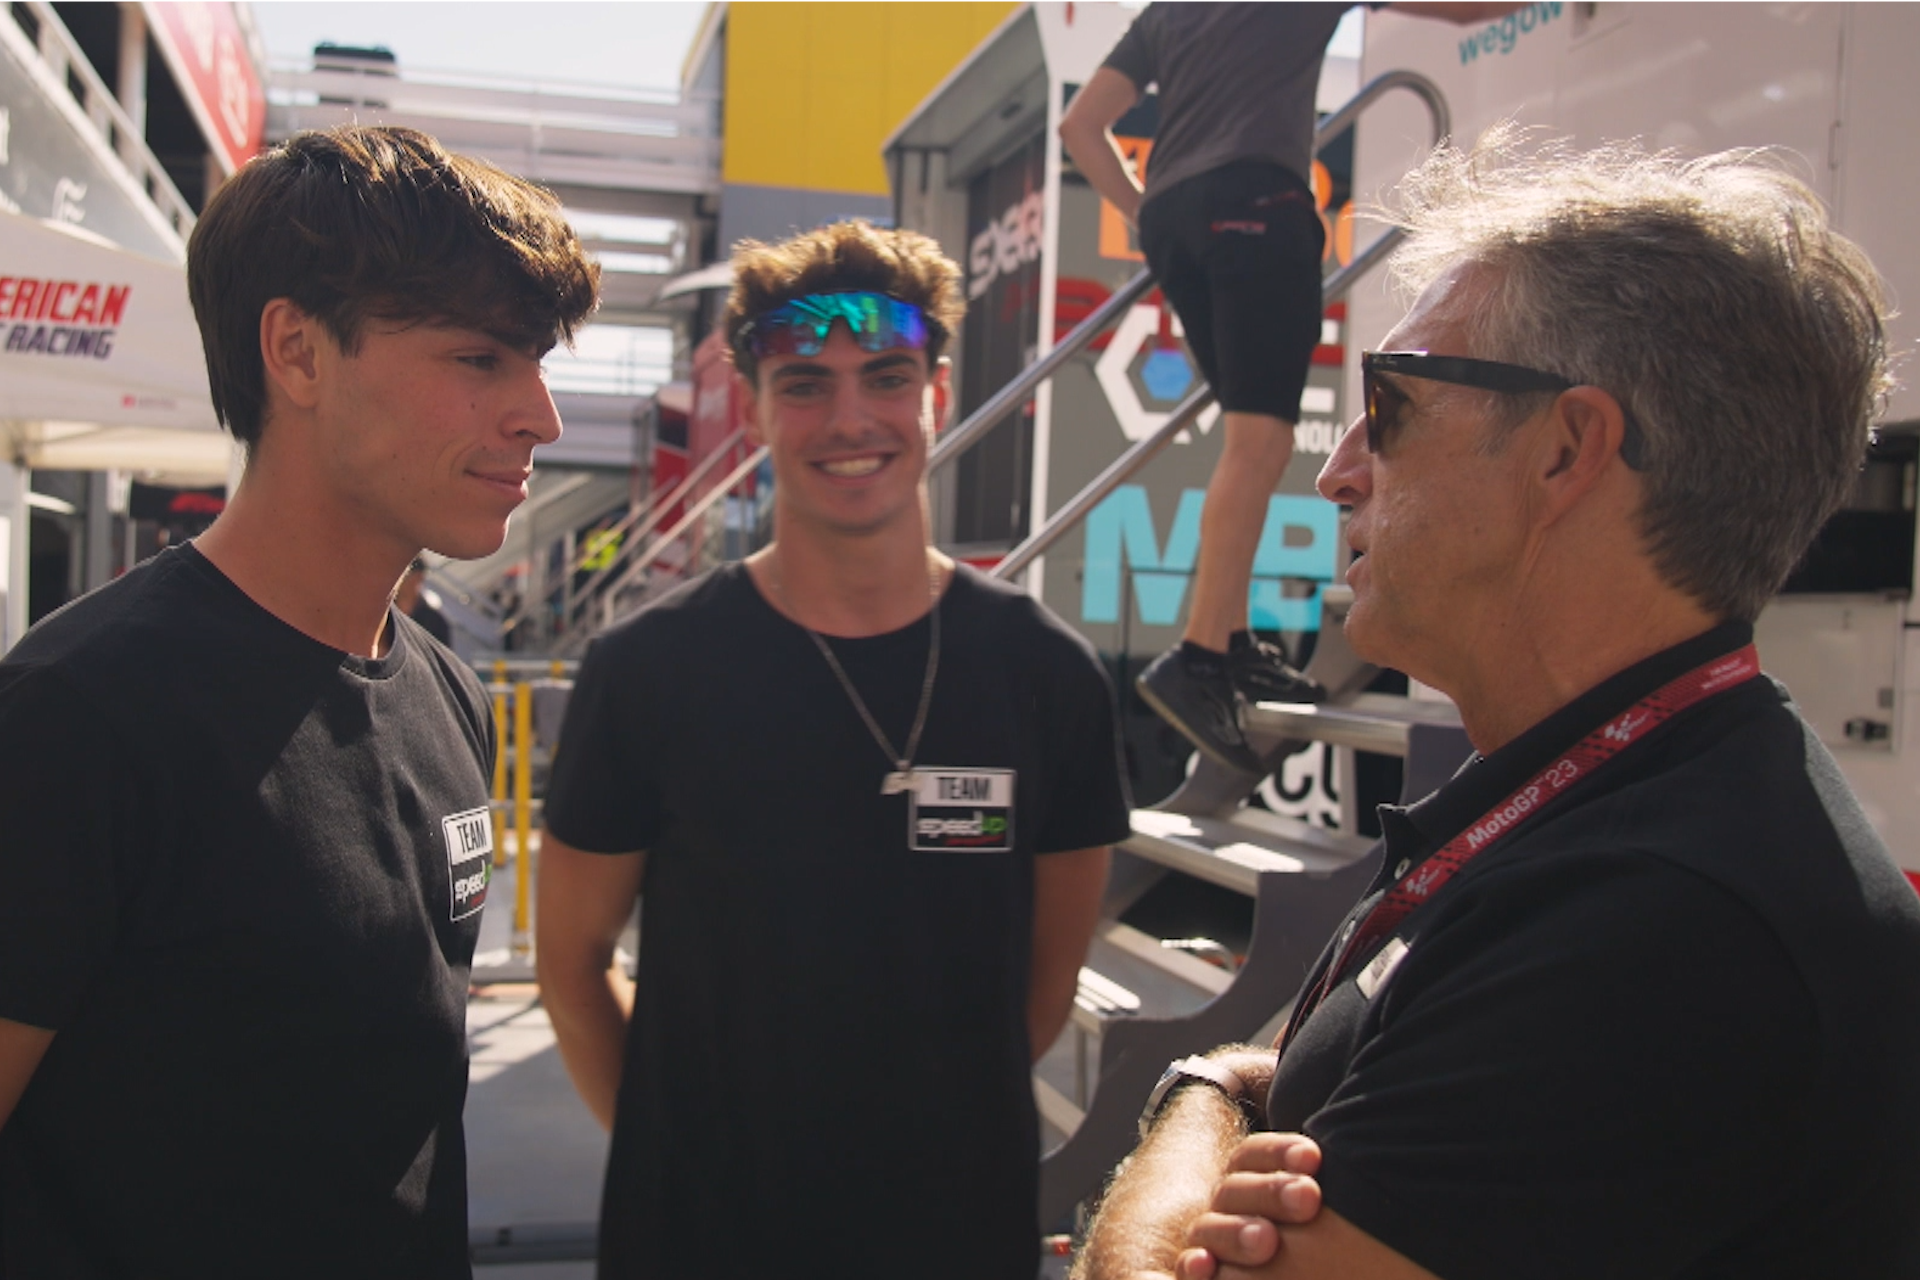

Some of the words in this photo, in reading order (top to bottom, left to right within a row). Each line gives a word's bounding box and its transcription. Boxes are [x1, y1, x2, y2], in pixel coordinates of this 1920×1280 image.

[5, 323, 115, 361] RACING
[936, 775, 992, 801] TEAM
[457, 817, 487, 855] TEAM
